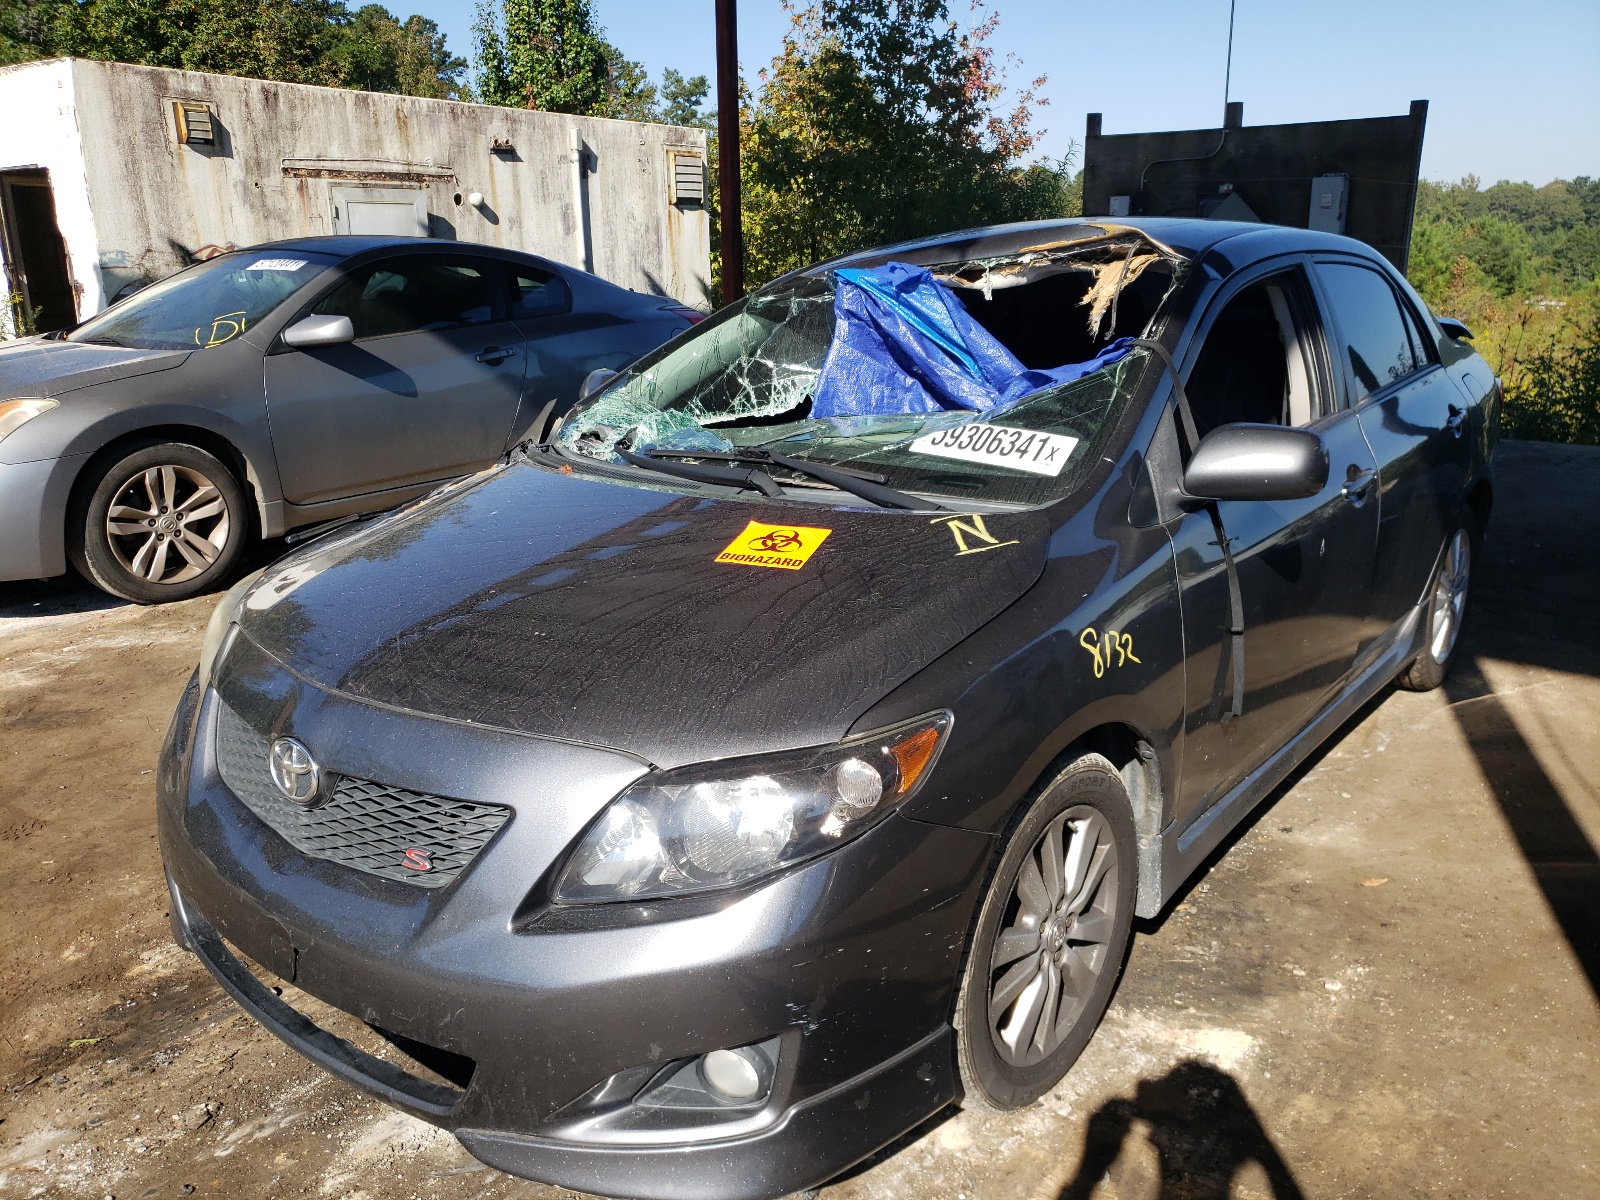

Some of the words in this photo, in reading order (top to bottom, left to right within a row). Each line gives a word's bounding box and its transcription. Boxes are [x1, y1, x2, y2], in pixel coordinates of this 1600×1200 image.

[940, 513, 1008, 555] N
[720, 552, 804, 567] BIOHAZARD
[401, 847, 433, 872] S
